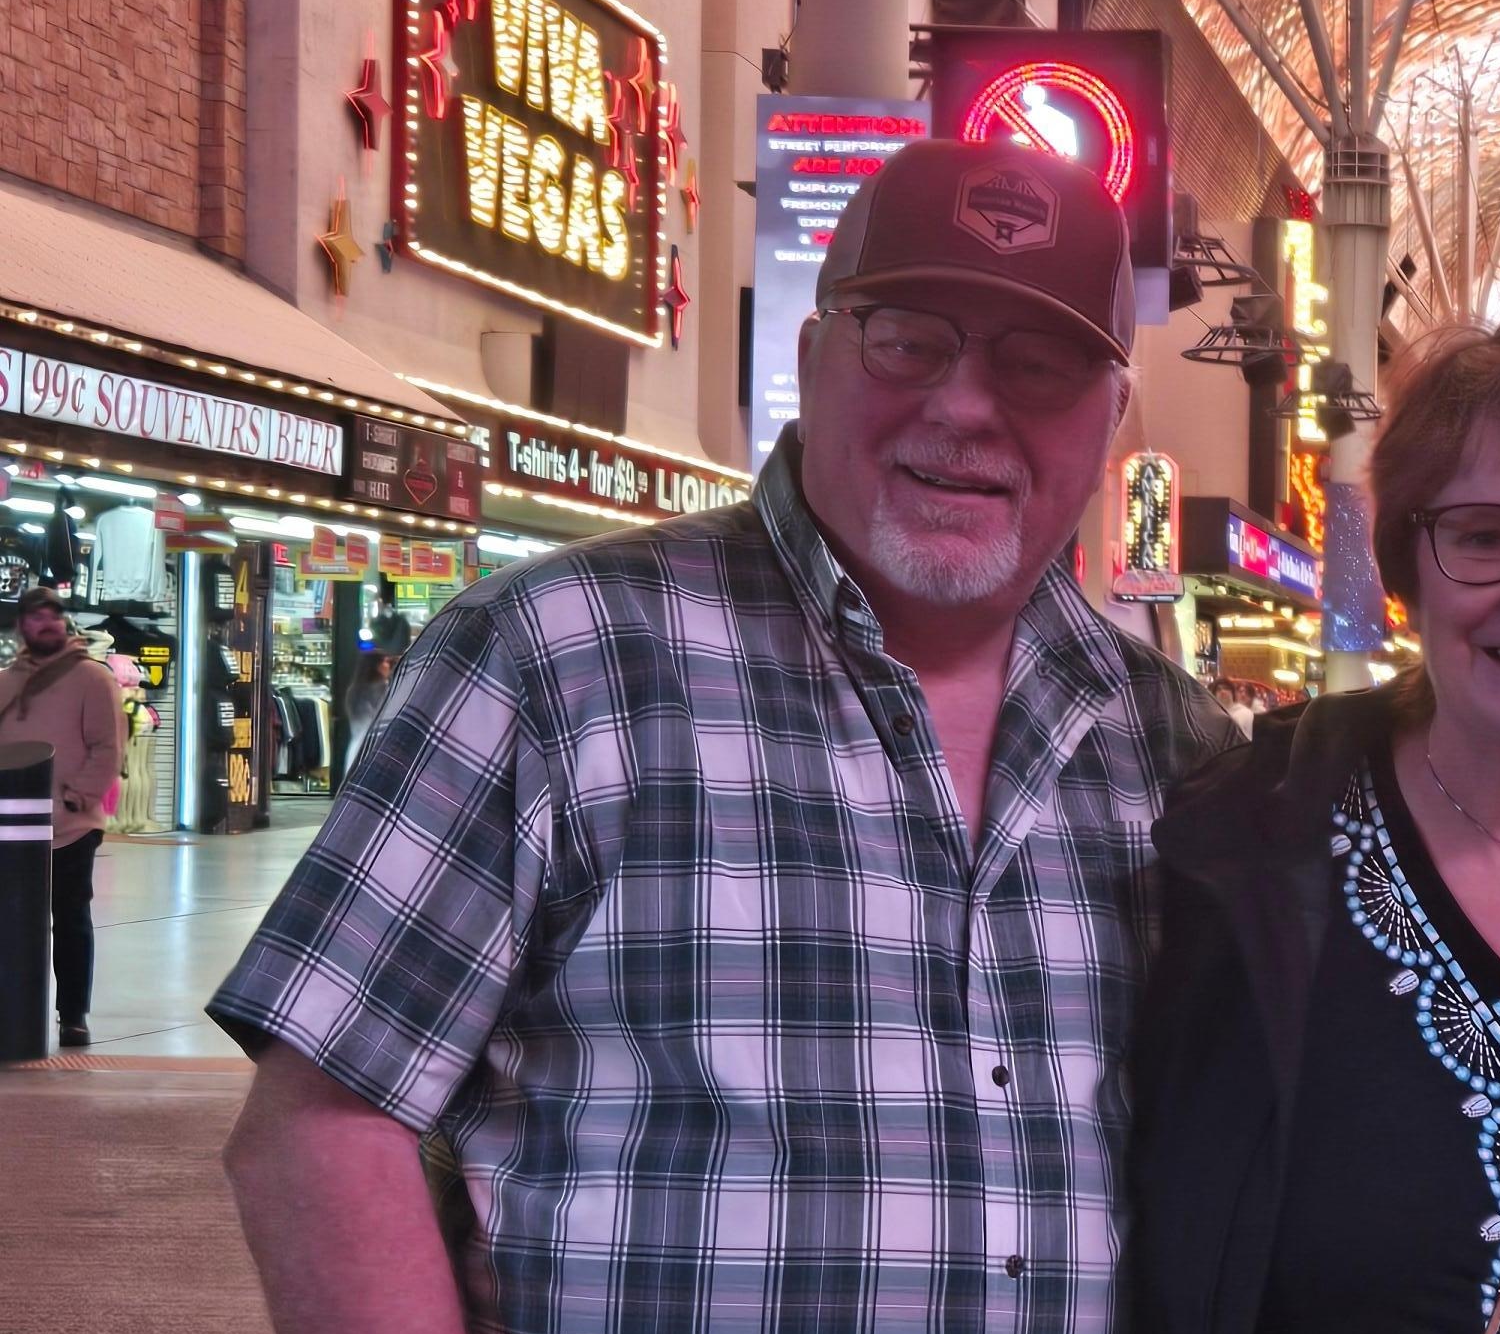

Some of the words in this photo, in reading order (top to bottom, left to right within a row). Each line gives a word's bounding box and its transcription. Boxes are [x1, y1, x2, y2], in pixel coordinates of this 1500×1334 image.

[768, 139, 820, 152] STREET
[792, 157, 841, 174] ARE
[845, 158, 885, 176] NO
[461, 93, 629, 282] VEGAS
[33, 358, 86, 420] 99¢
[94, 373, 262, 456] SOUVENIRS
[273, 412, 338, 474] BEER
[507, 431, 566, 484] T-shirts
[589, 450, 614, 498] for
